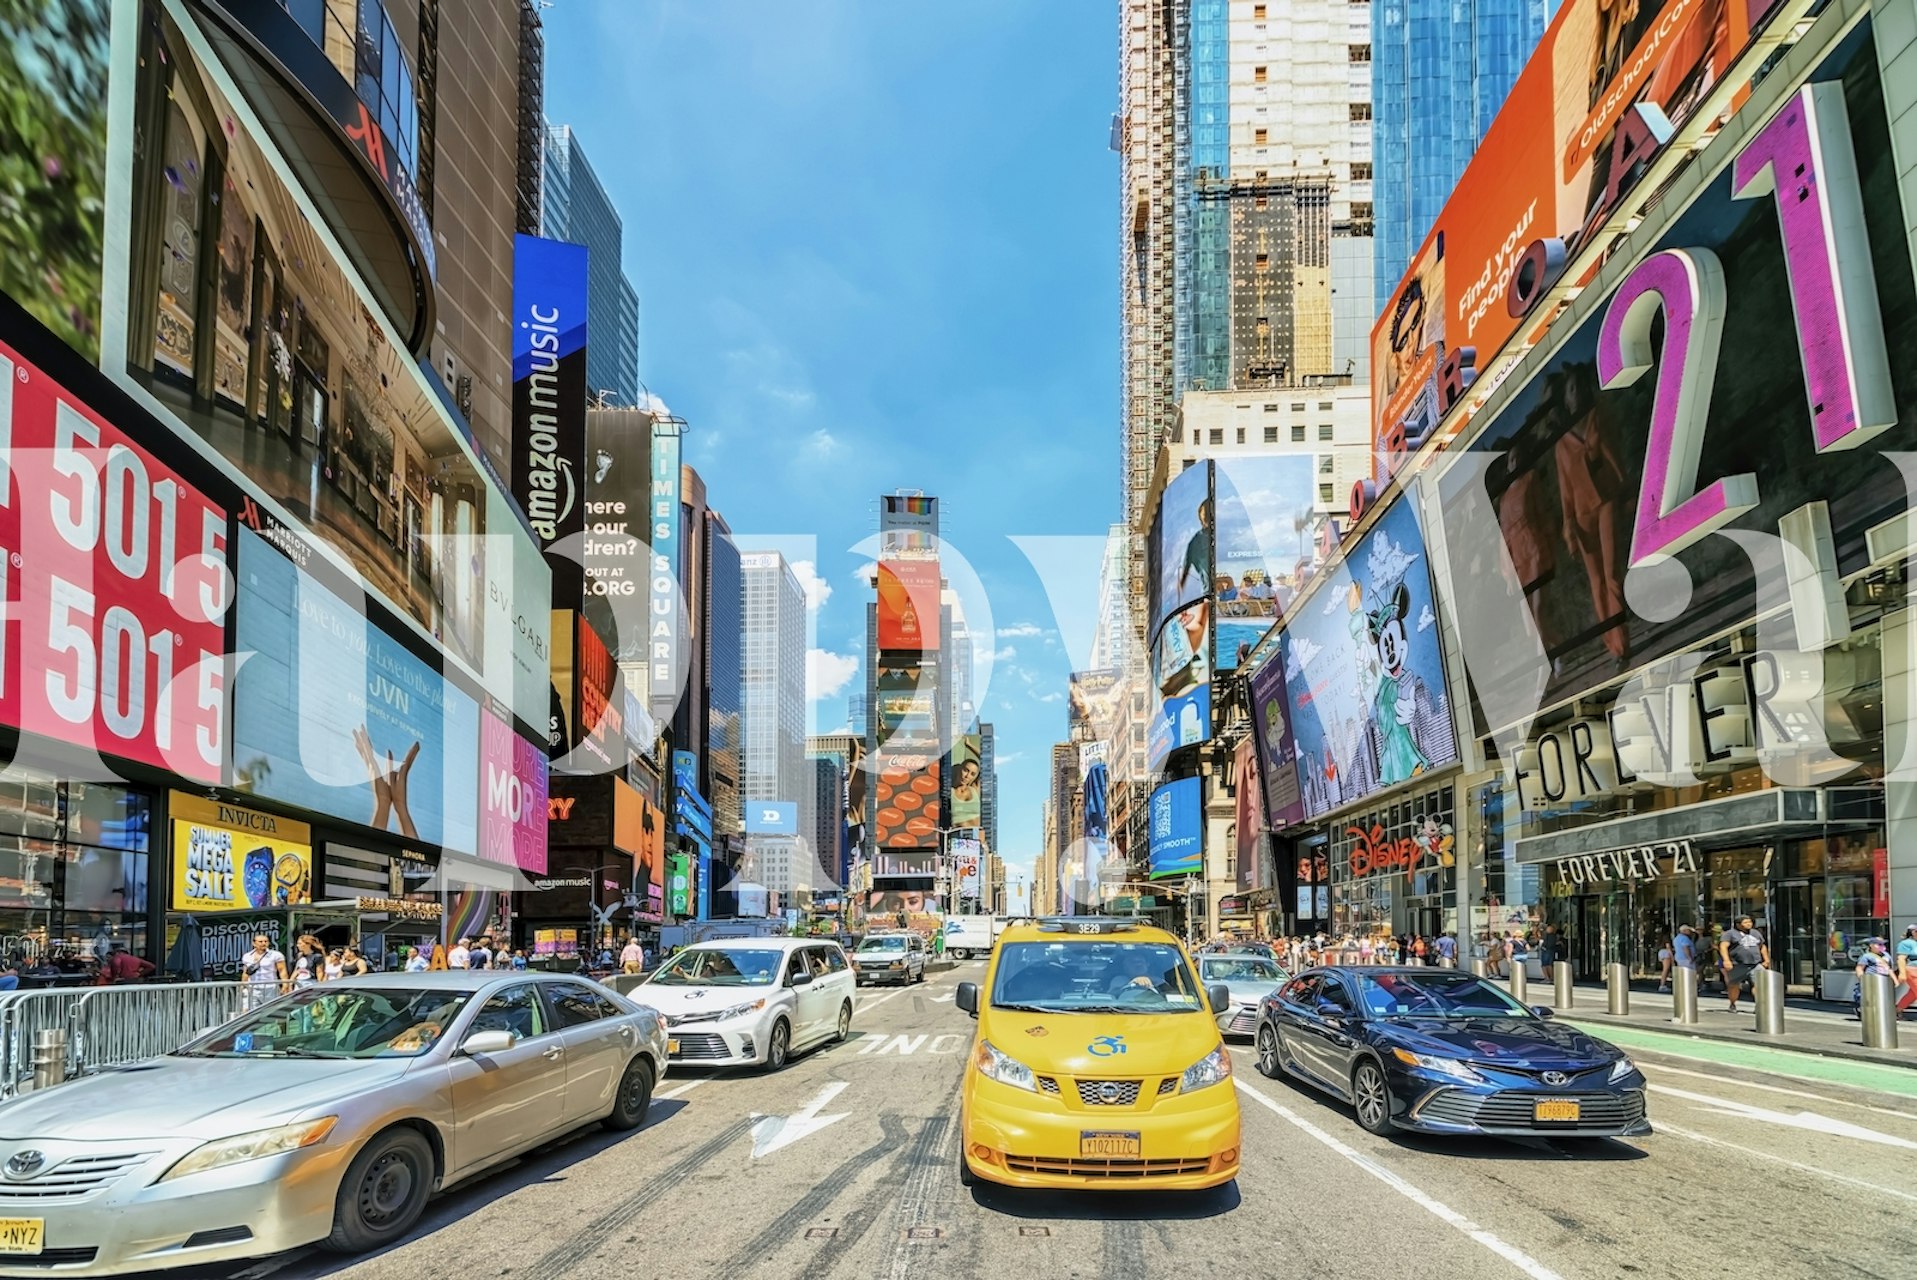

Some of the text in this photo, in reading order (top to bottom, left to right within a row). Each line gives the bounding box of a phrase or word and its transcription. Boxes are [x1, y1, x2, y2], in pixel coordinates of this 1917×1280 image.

[1459, 197, 1538, 321] Find your
[1468, 246, 1526, 339] people
[1598, 79, 1898, 568] 21
[521, 304, 560, 541] amazon music
[266, 516, 312, 557] MARRIOTT
[593, 522, 628, 535] our
[266, 529, 307, 566] MARQUIS
[653, 437, 673, 681] TIMES SQUARE
[584, 580, 636, 596] .ORG
[585, 567, 624, 577] OUT AT
[332, 616, 346, 639] to
[375, 643, 402, 678] Love
[402, 668, 415, 686] to
[414, 671, 431, 697] the
[369, 674, 410, 715] JVN
[1510, 650, 1795, 811] FOREVER
[487, 762, 545, 835] MORE
[217, 805, 278, 833] INVICTA
[190, 826, 232, 849] SUMMER
[187, 842, 235, 874] MEGA
[1557, 840, 1697, 885] FOREVER 21
[184, 868, 235, 900] SALE
[535, 877, 591, 891] amazon music
[202, 919, 280, 937] DISCOVER
[1079, 924, 1100, 934] 3E29
[1087, 1140, 1133, 1153] Y102117C
[10, 1227, 37, 1245] NYZ
